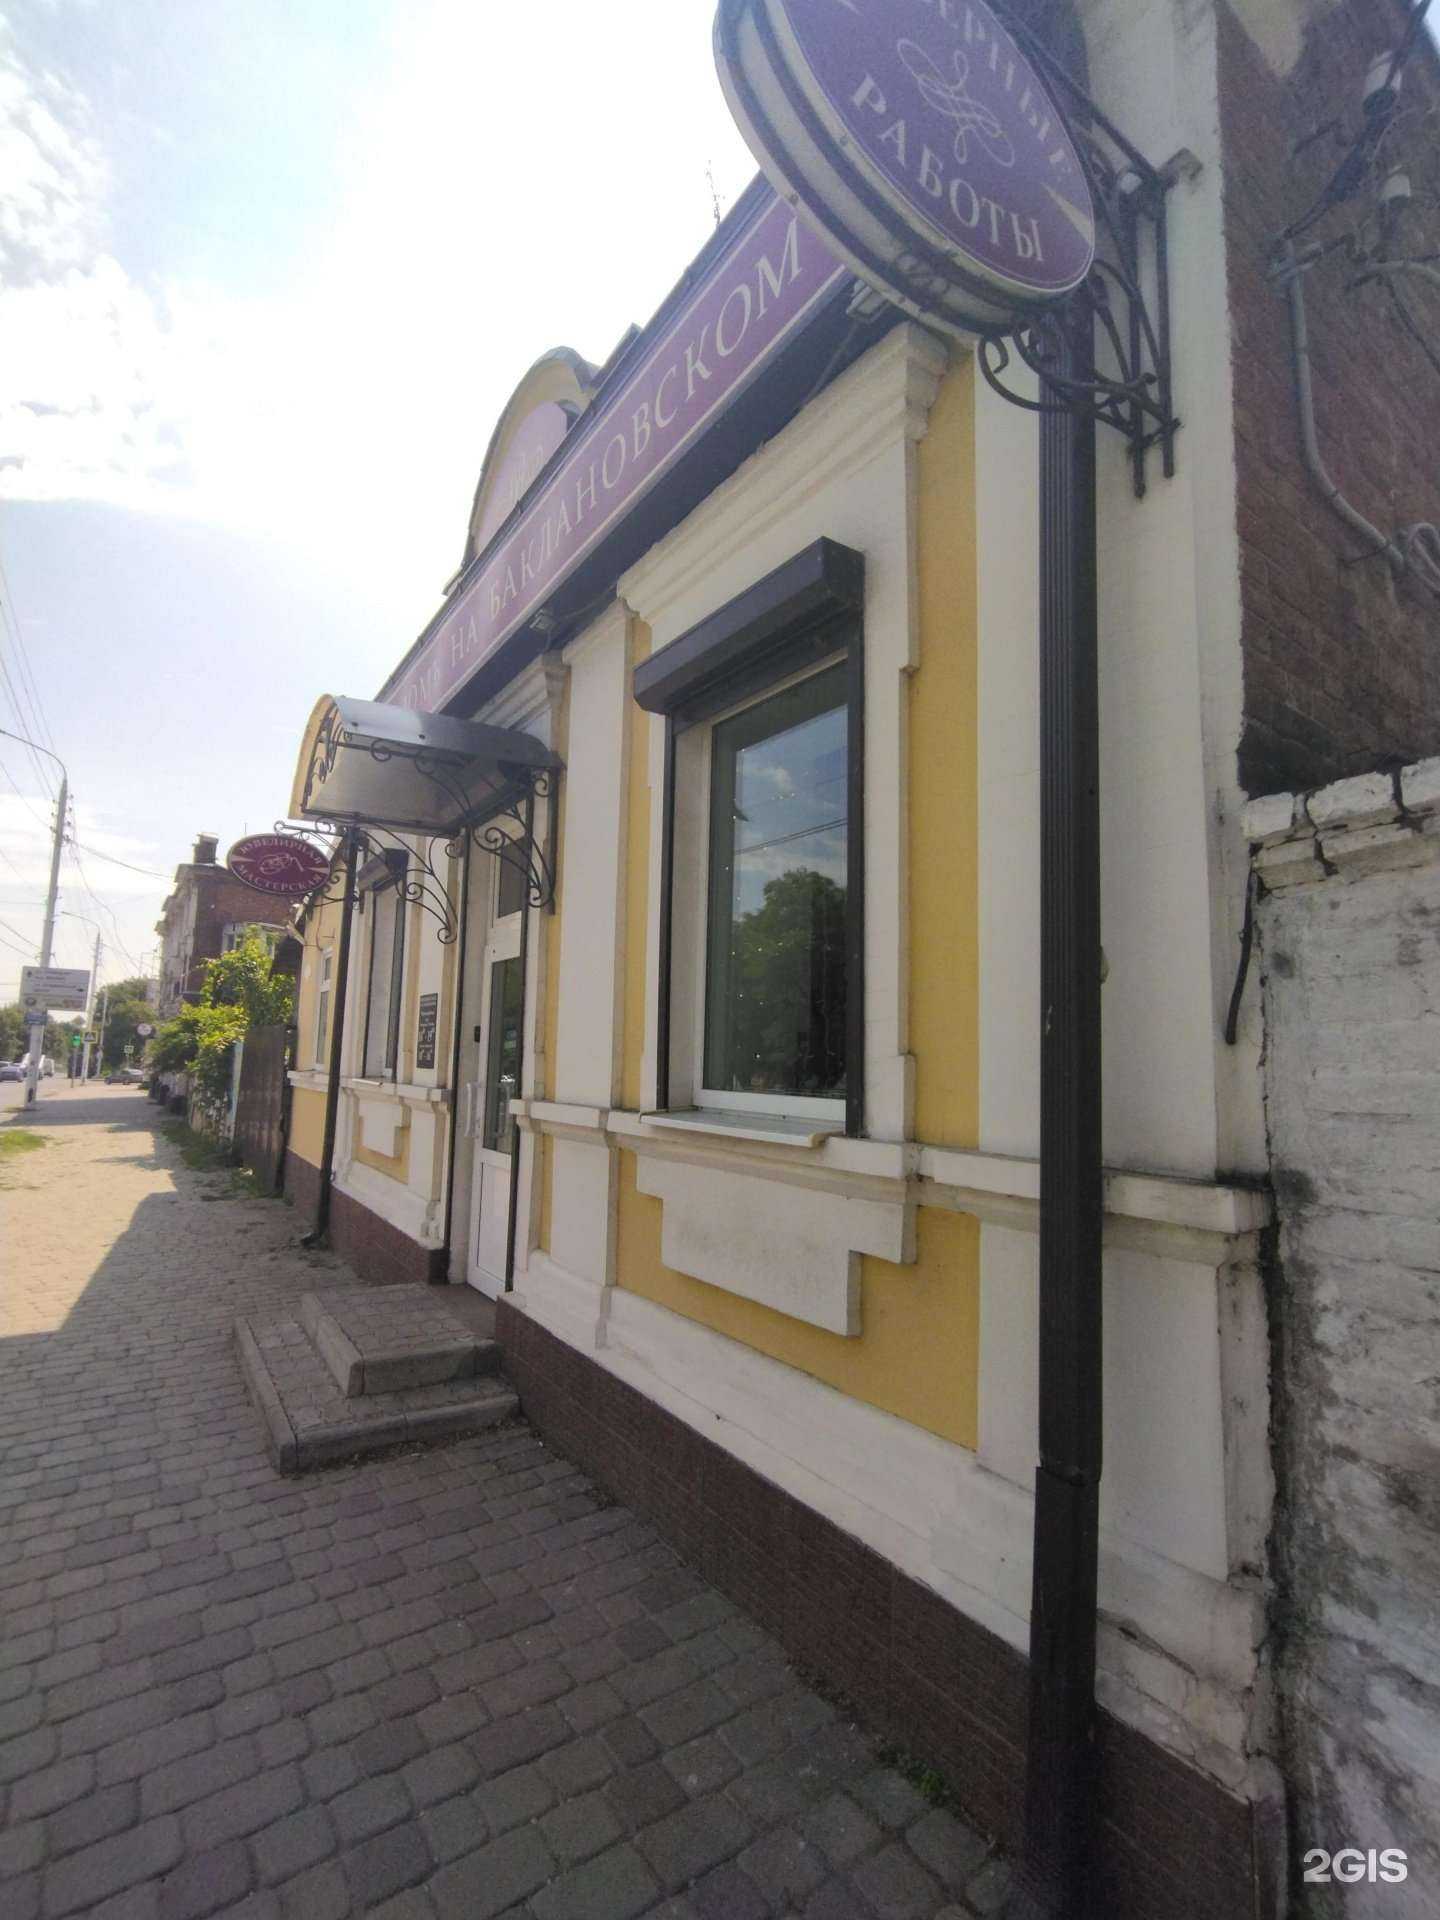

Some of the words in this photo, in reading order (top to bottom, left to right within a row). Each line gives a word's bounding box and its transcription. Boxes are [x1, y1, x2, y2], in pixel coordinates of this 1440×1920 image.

[851, 73, 1044, 262] РАБОТЫ
[450, 615, 479, 669] НА
[488, 216, 803, 621] БАКЛАНОВСКОМ
[237, 863, 323, 892] МАСТЕРСКАЯ
